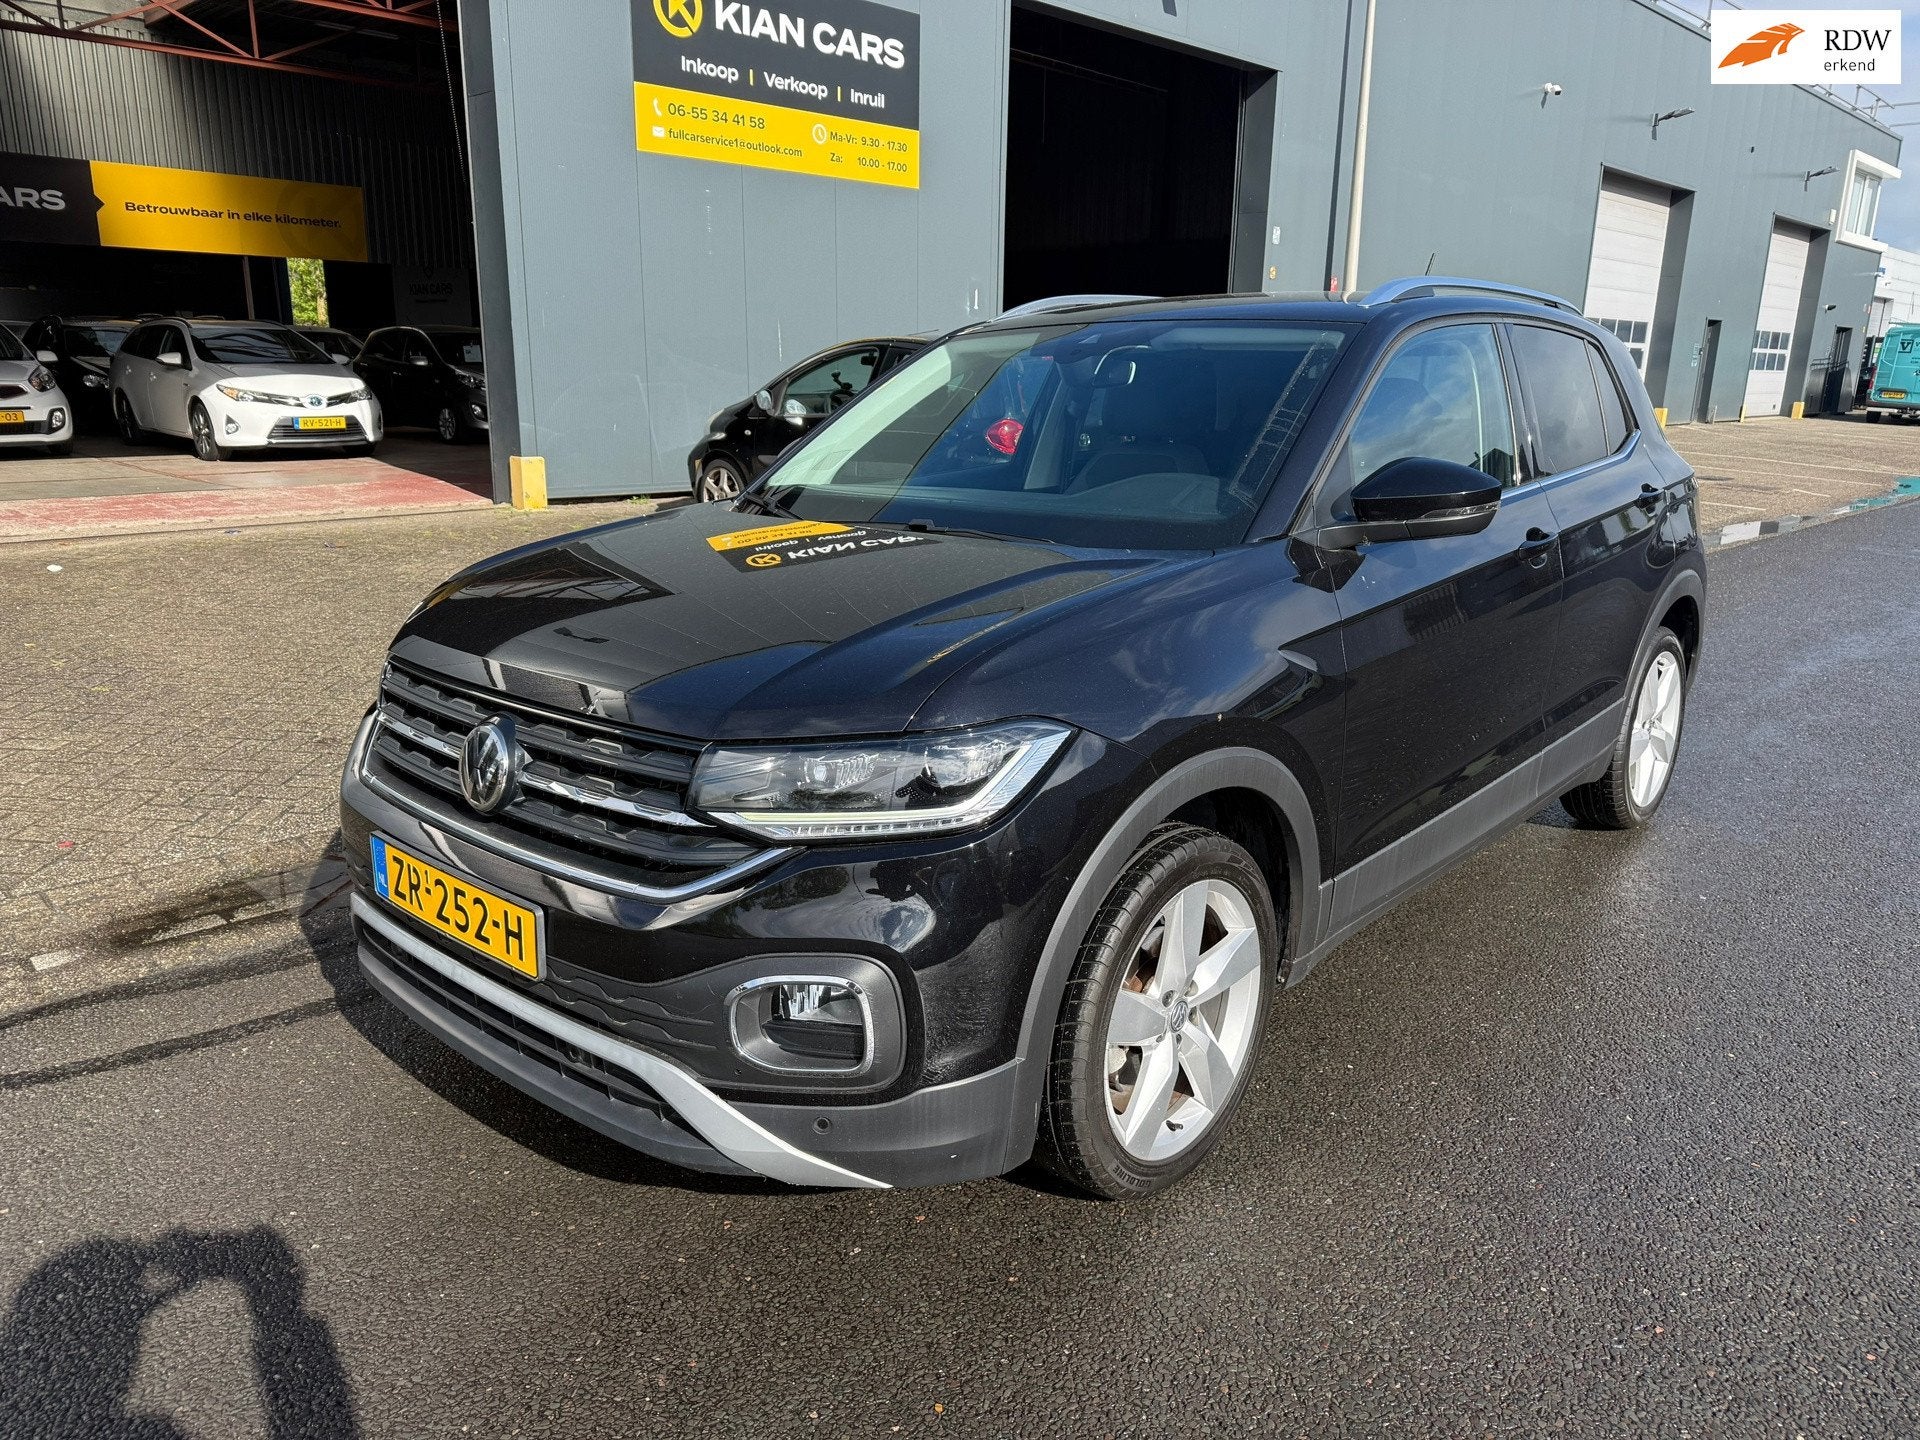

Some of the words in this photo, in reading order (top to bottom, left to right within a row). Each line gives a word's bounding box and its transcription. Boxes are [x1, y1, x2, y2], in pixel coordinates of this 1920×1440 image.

[715, 0, 805, 48] KIAN
[812, 22, 905, 69] CARS
[681, 55, 739, 83] Inkoop
[764, 71, 828, 100] Verkoop
[850, 88, 885, 109] Inruil
[667, 103, 708, 121] 06-55
[711, 110, 729, 124] 34
[732, 113, 746, 126] 41
[749, 116, 766, 130] 58
[668, 128, 803, 157] fullcarservice1@outlook.com
[830, 131, 857, 145] Ma-Vr:
[861, 136, 880, 149] 9.30
[887, 140, 907, 152] 17.30
[830, 152, 843, 164] Za:
[857, 156, 880, 169] 10.00
[887, 161, 907, 173] 17.00
[125, 201, 224, 219] Betrouwbaar
[227, 209, 240, 220] in
[244, 212, 272, 223] elke
[275, 213, 342, 229] kilometer.
[392, 855, 525, 962] ZR-252-H
